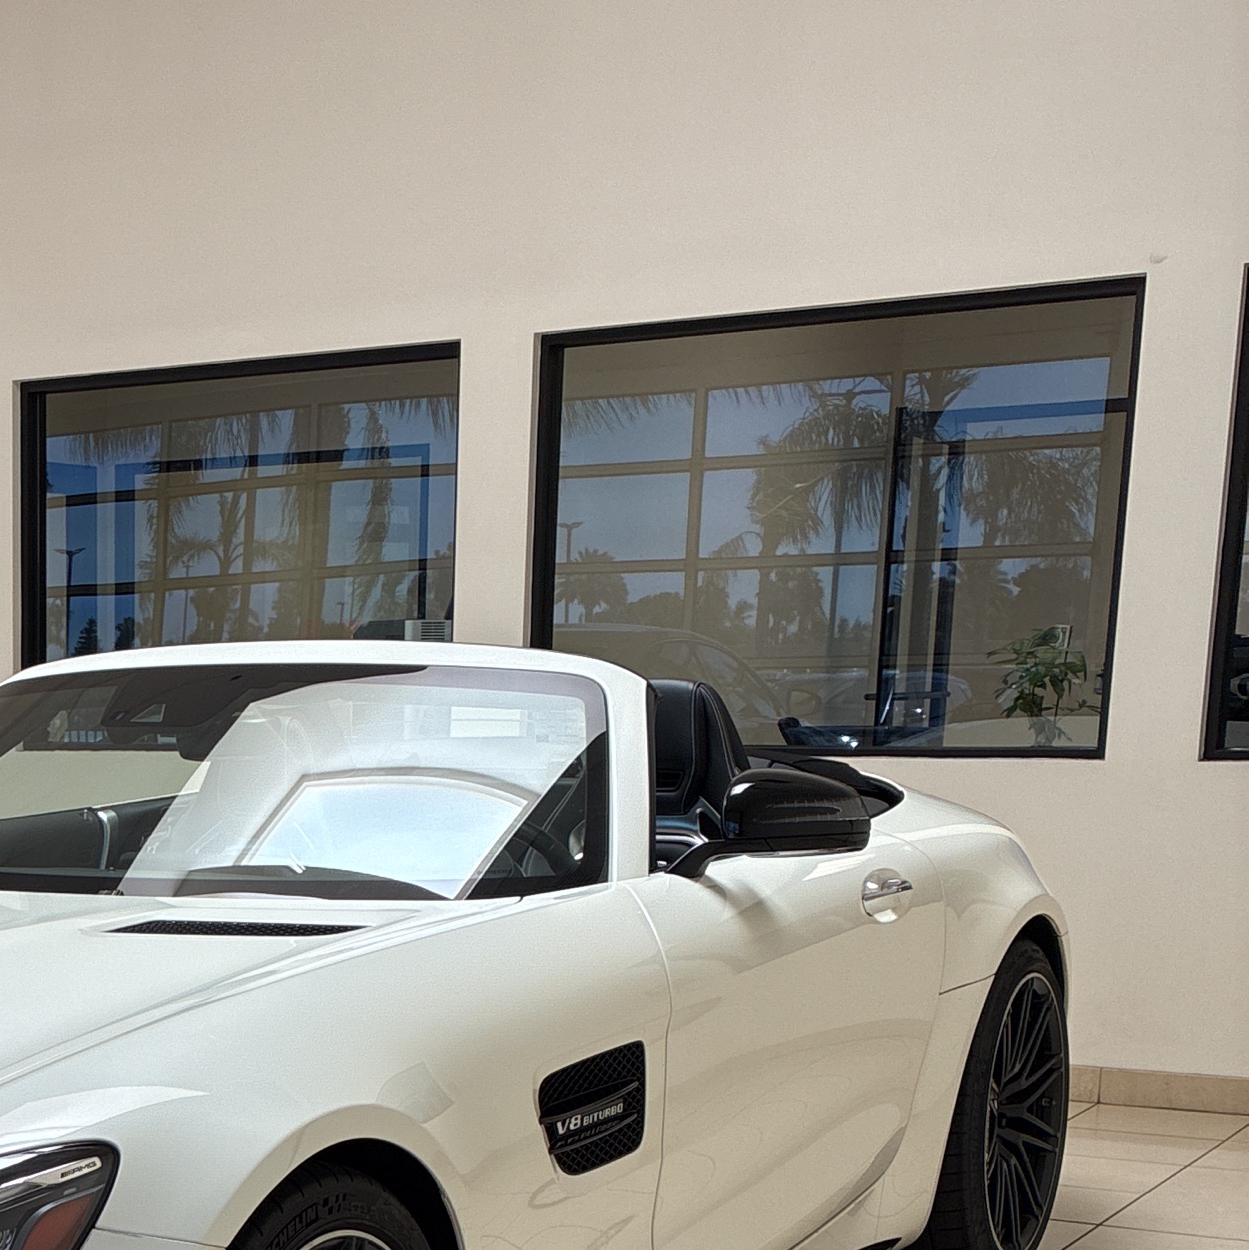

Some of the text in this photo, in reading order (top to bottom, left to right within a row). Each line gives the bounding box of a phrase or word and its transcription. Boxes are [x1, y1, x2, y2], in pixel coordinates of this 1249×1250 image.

[556, 1102, 624, 1135] V8 BITURBO
[71, 1160, 98, 1174] AMG
